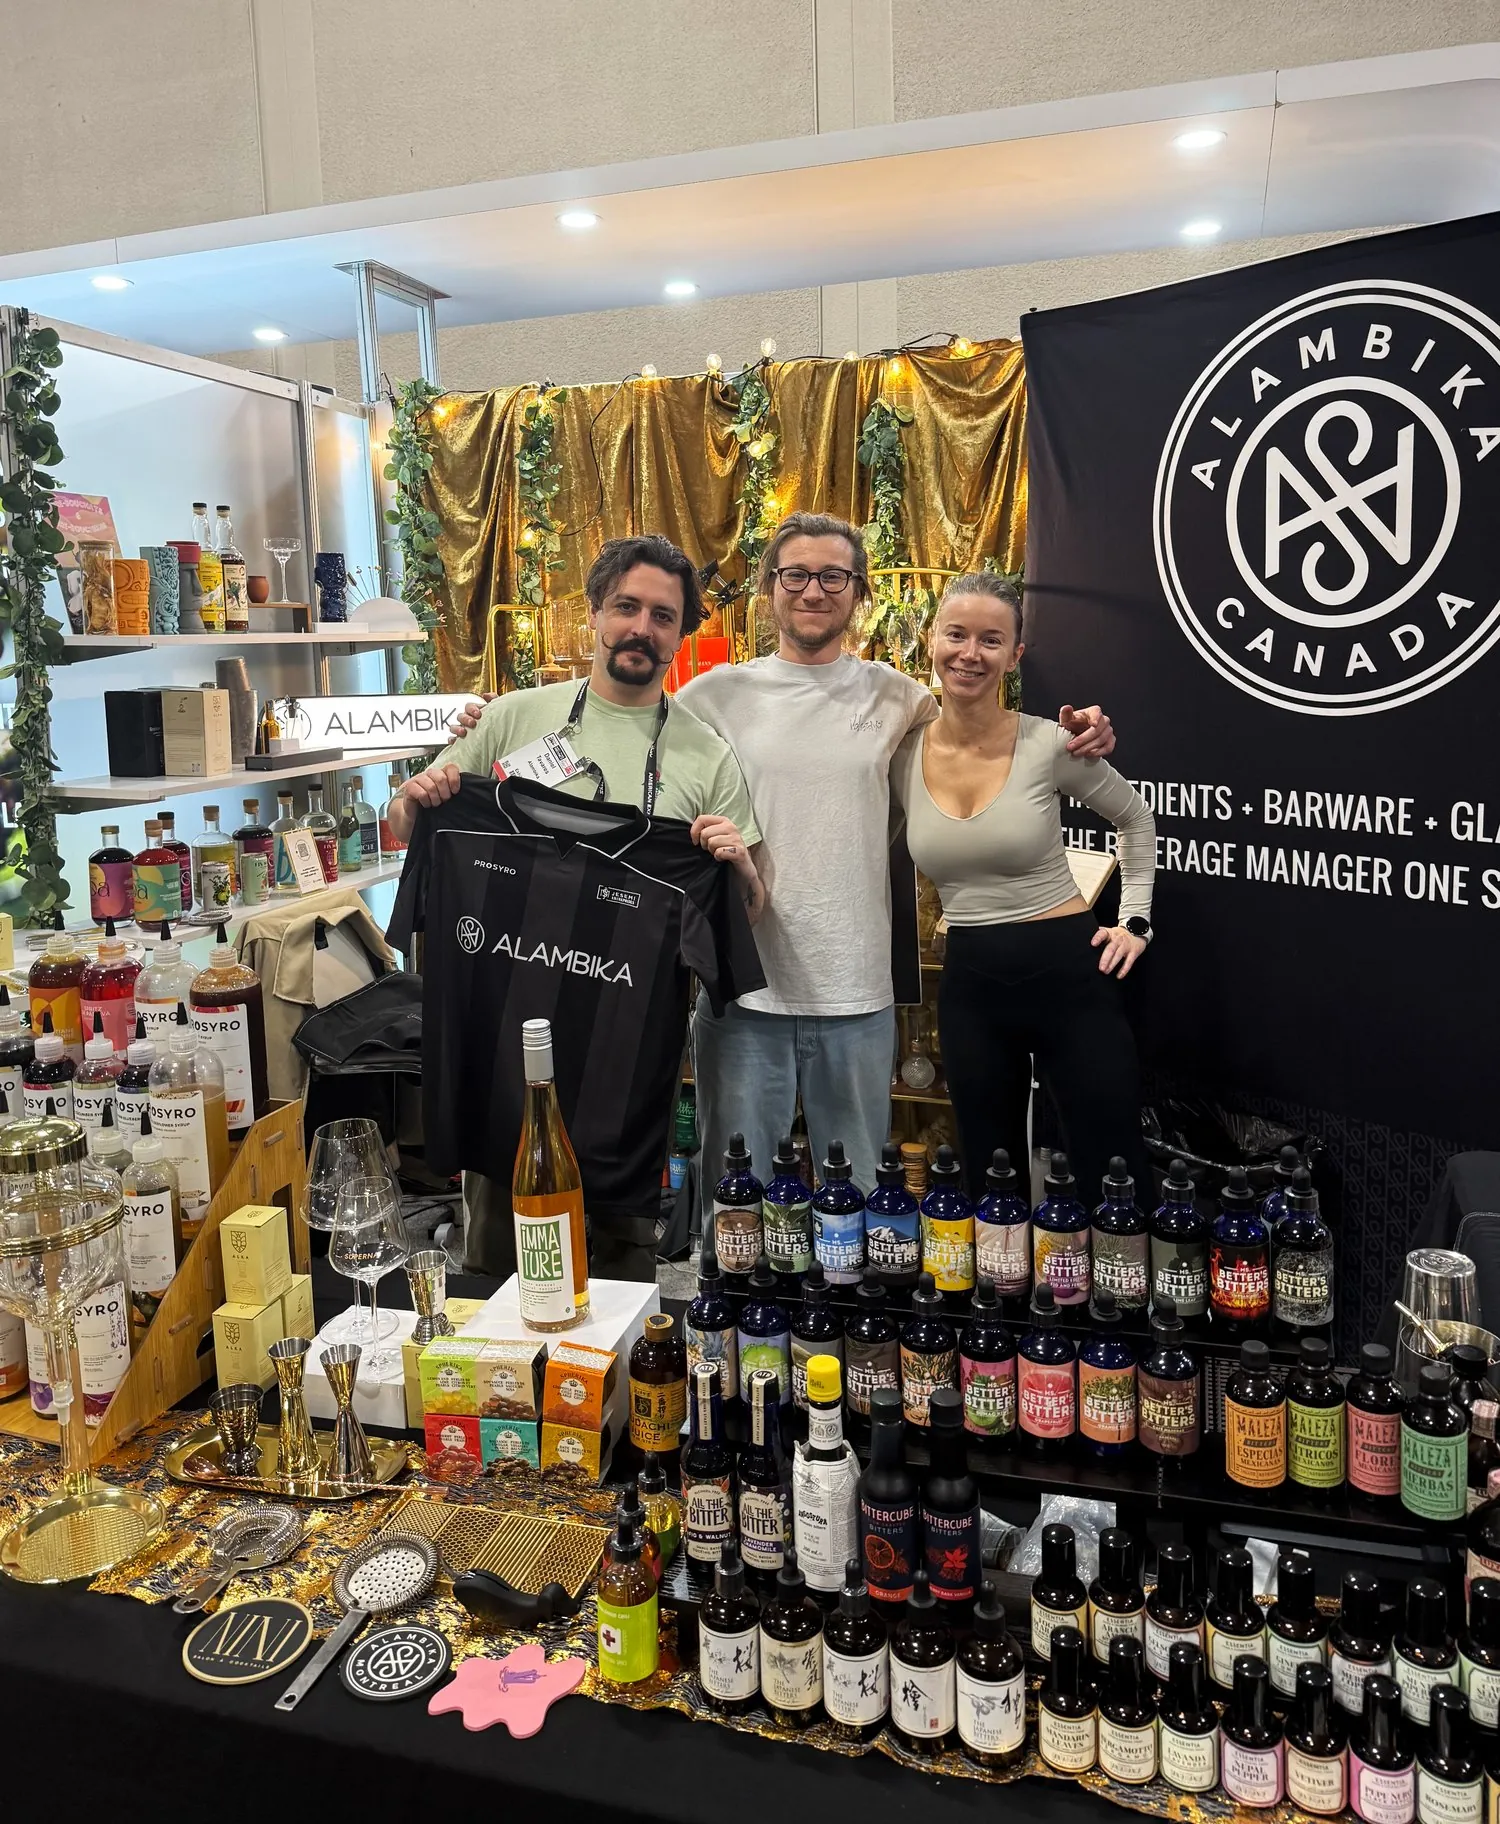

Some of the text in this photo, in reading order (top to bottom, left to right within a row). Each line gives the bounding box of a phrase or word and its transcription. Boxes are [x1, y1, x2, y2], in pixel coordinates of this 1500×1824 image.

[1191, 323, 1500, 490] ALAMBIKA
[1216, 591, 1475, 677] CANADA
[324, 707, 456, 736] ALAMBIK
[1263, 788, 1414, 836] BARWARE
[474, 859, 517, 876] PROSYRO
[1105, 831, 1236, 878] BERAGE
[1246, 844, 1392, 896] MANAGER
[1404, 861, 1470, 906] ONE
[492, 933, 633, 987] ALAMBIKA
[718, 1231, 762, 1244] BETTER'S
[868, 1237, 916, 1251] BETTER'S
[925, 1239, 969, 1253] BETTER'S
[816, 1241, 863, 1255] BETTER'S
[868, 1246, 919, 1263] BITTERS
[924, 1247, 972, 1263] BITTERS
[522, 1249, 562, 1278] TURE
[815, 1250, 863, 1266] BITTERS
[1044, 1253, 1089, 1266] BETTER'S
[1042, 1260, 1090, 1276] BITTERS
[1094, 1259, 1144, 1277] BETTER'S
[1218, 1268, 1268, 1282] BETTER'S
[1094, 1268, 1146, 1289] BITTERS
[1157, 1270, 1207, 1285] BETTER'S
[1217, 1278, 1268, 1293] BITTERS
[1276, 1270, 1327, 1285] BETTER'S
[1156, 1280, 1208, 1297] BITTERS
[1275, 1279, 1328, 1298] BITTERS
[848, 1368, 896, 1384] BETTER'S
[1024, 1390, 1074, 1406] BETTER'S
[1022, 1398, 1075, 1418] BITTERS
[1144, 1399, 1194, 1416] BETTER'S
[1142, 1407, 1195, 1427] BITTERS
[1236, 1414, 1281, 1438] MALEZA
[1237, 1446, 1283, 1460] ESPECIAS
[1403, 1467, 1454, 1491] HIERBAS
[706, 1497, 724, 1509] THE
[861, 1499, 914, 1522] BITTERCUBE
[690, 1507, 729, 1526] BITTER
[755, 1507, 773, 1519] THE
[923, 1509, 972, 1529] BITTERCUBE
[741, 1516, 778, 1535] BITTER
[869, 1524, 904, 1535] BITTERS
[931, 1526, 962, 1536] BITTERS
[744, 1537, 773, 1547] LAVENDER
[371, 1633, 437, 1664] ALAMBIKA
[229, 1660, 270, 1669] COCKTAILS
[356, 1659, 423, 1690] MONTREAL
